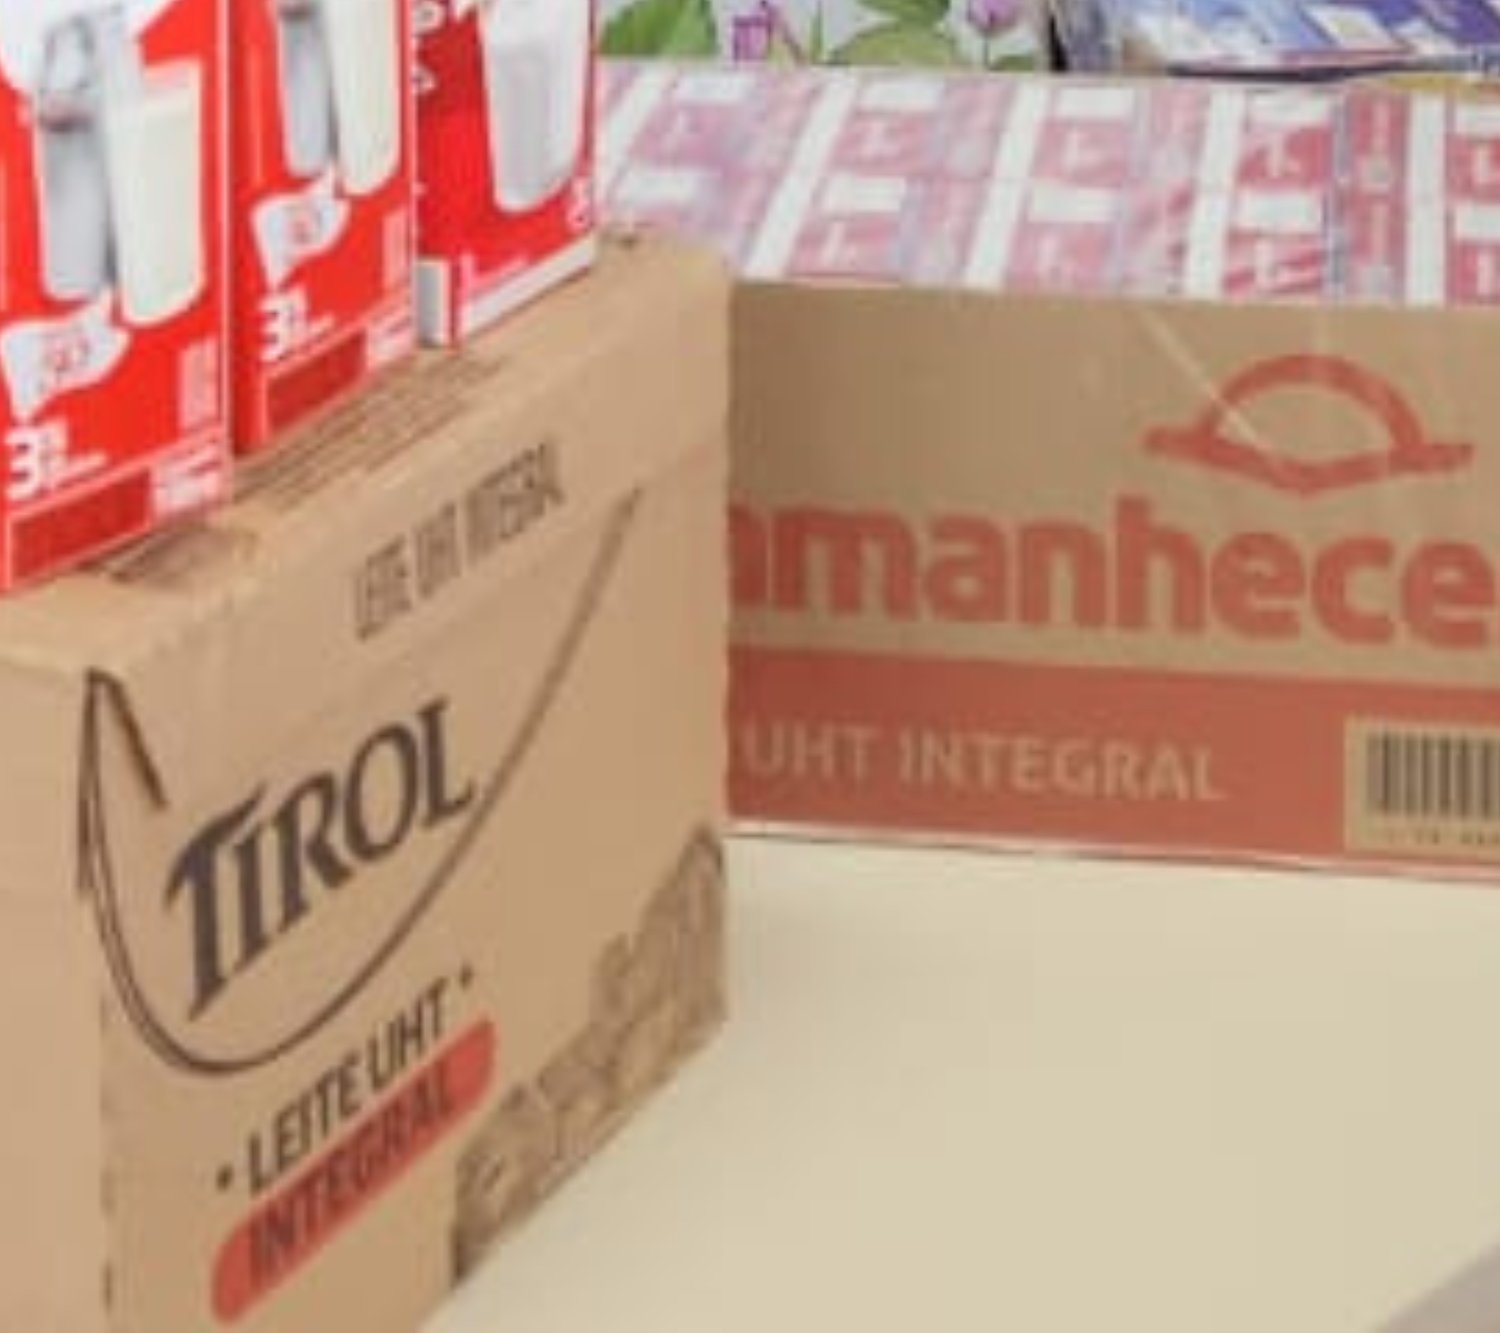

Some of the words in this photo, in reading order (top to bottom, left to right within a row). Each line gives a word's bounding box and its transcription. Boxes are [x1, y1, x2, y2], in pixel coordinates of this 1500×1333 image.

[165, 696, 477, 1022] TIROL
[899, 727, 1224, 805] INTEGRAL
[249, 1050, 362, 1196] LEITE
[368, 978, 448, 1090] UHT
[250, 1062, 450, 1283] INTEGRAL
